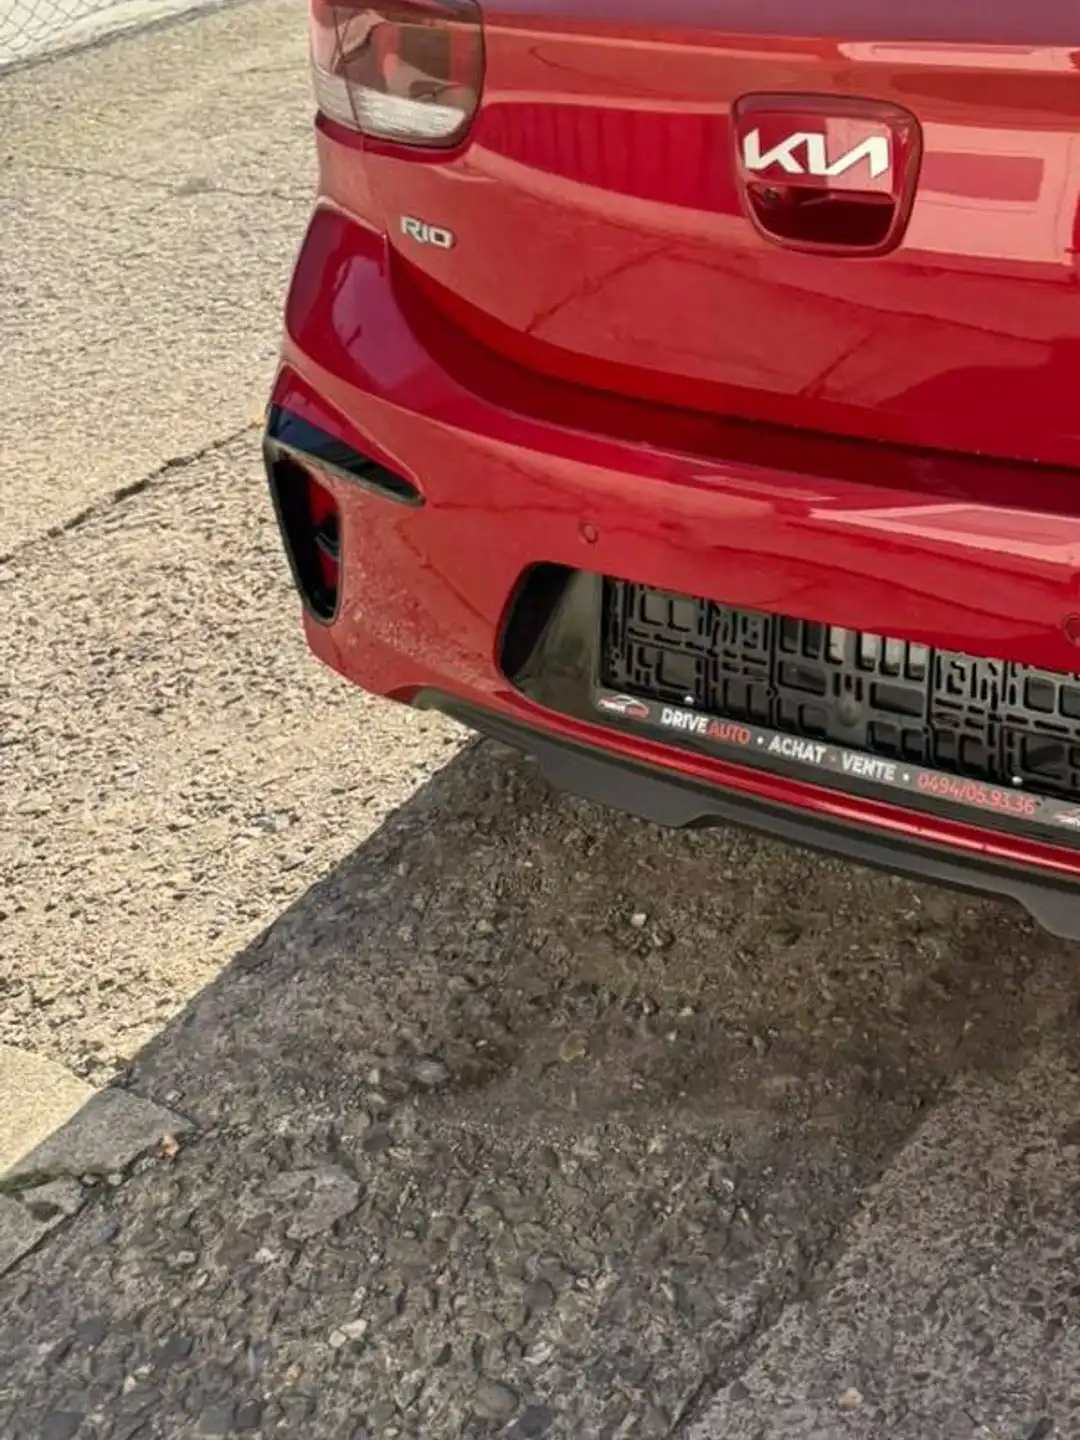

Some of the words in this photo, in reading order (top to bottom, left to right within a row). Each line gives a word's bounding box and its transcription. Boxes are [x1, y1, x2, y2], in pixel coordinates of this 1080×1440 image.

[743, 127, 889, 179] KIA
[400, 215, 454, 249] RIO
[768, 734, 828, 764] ACHAT
[840, 752, 898, 782] VENTE
